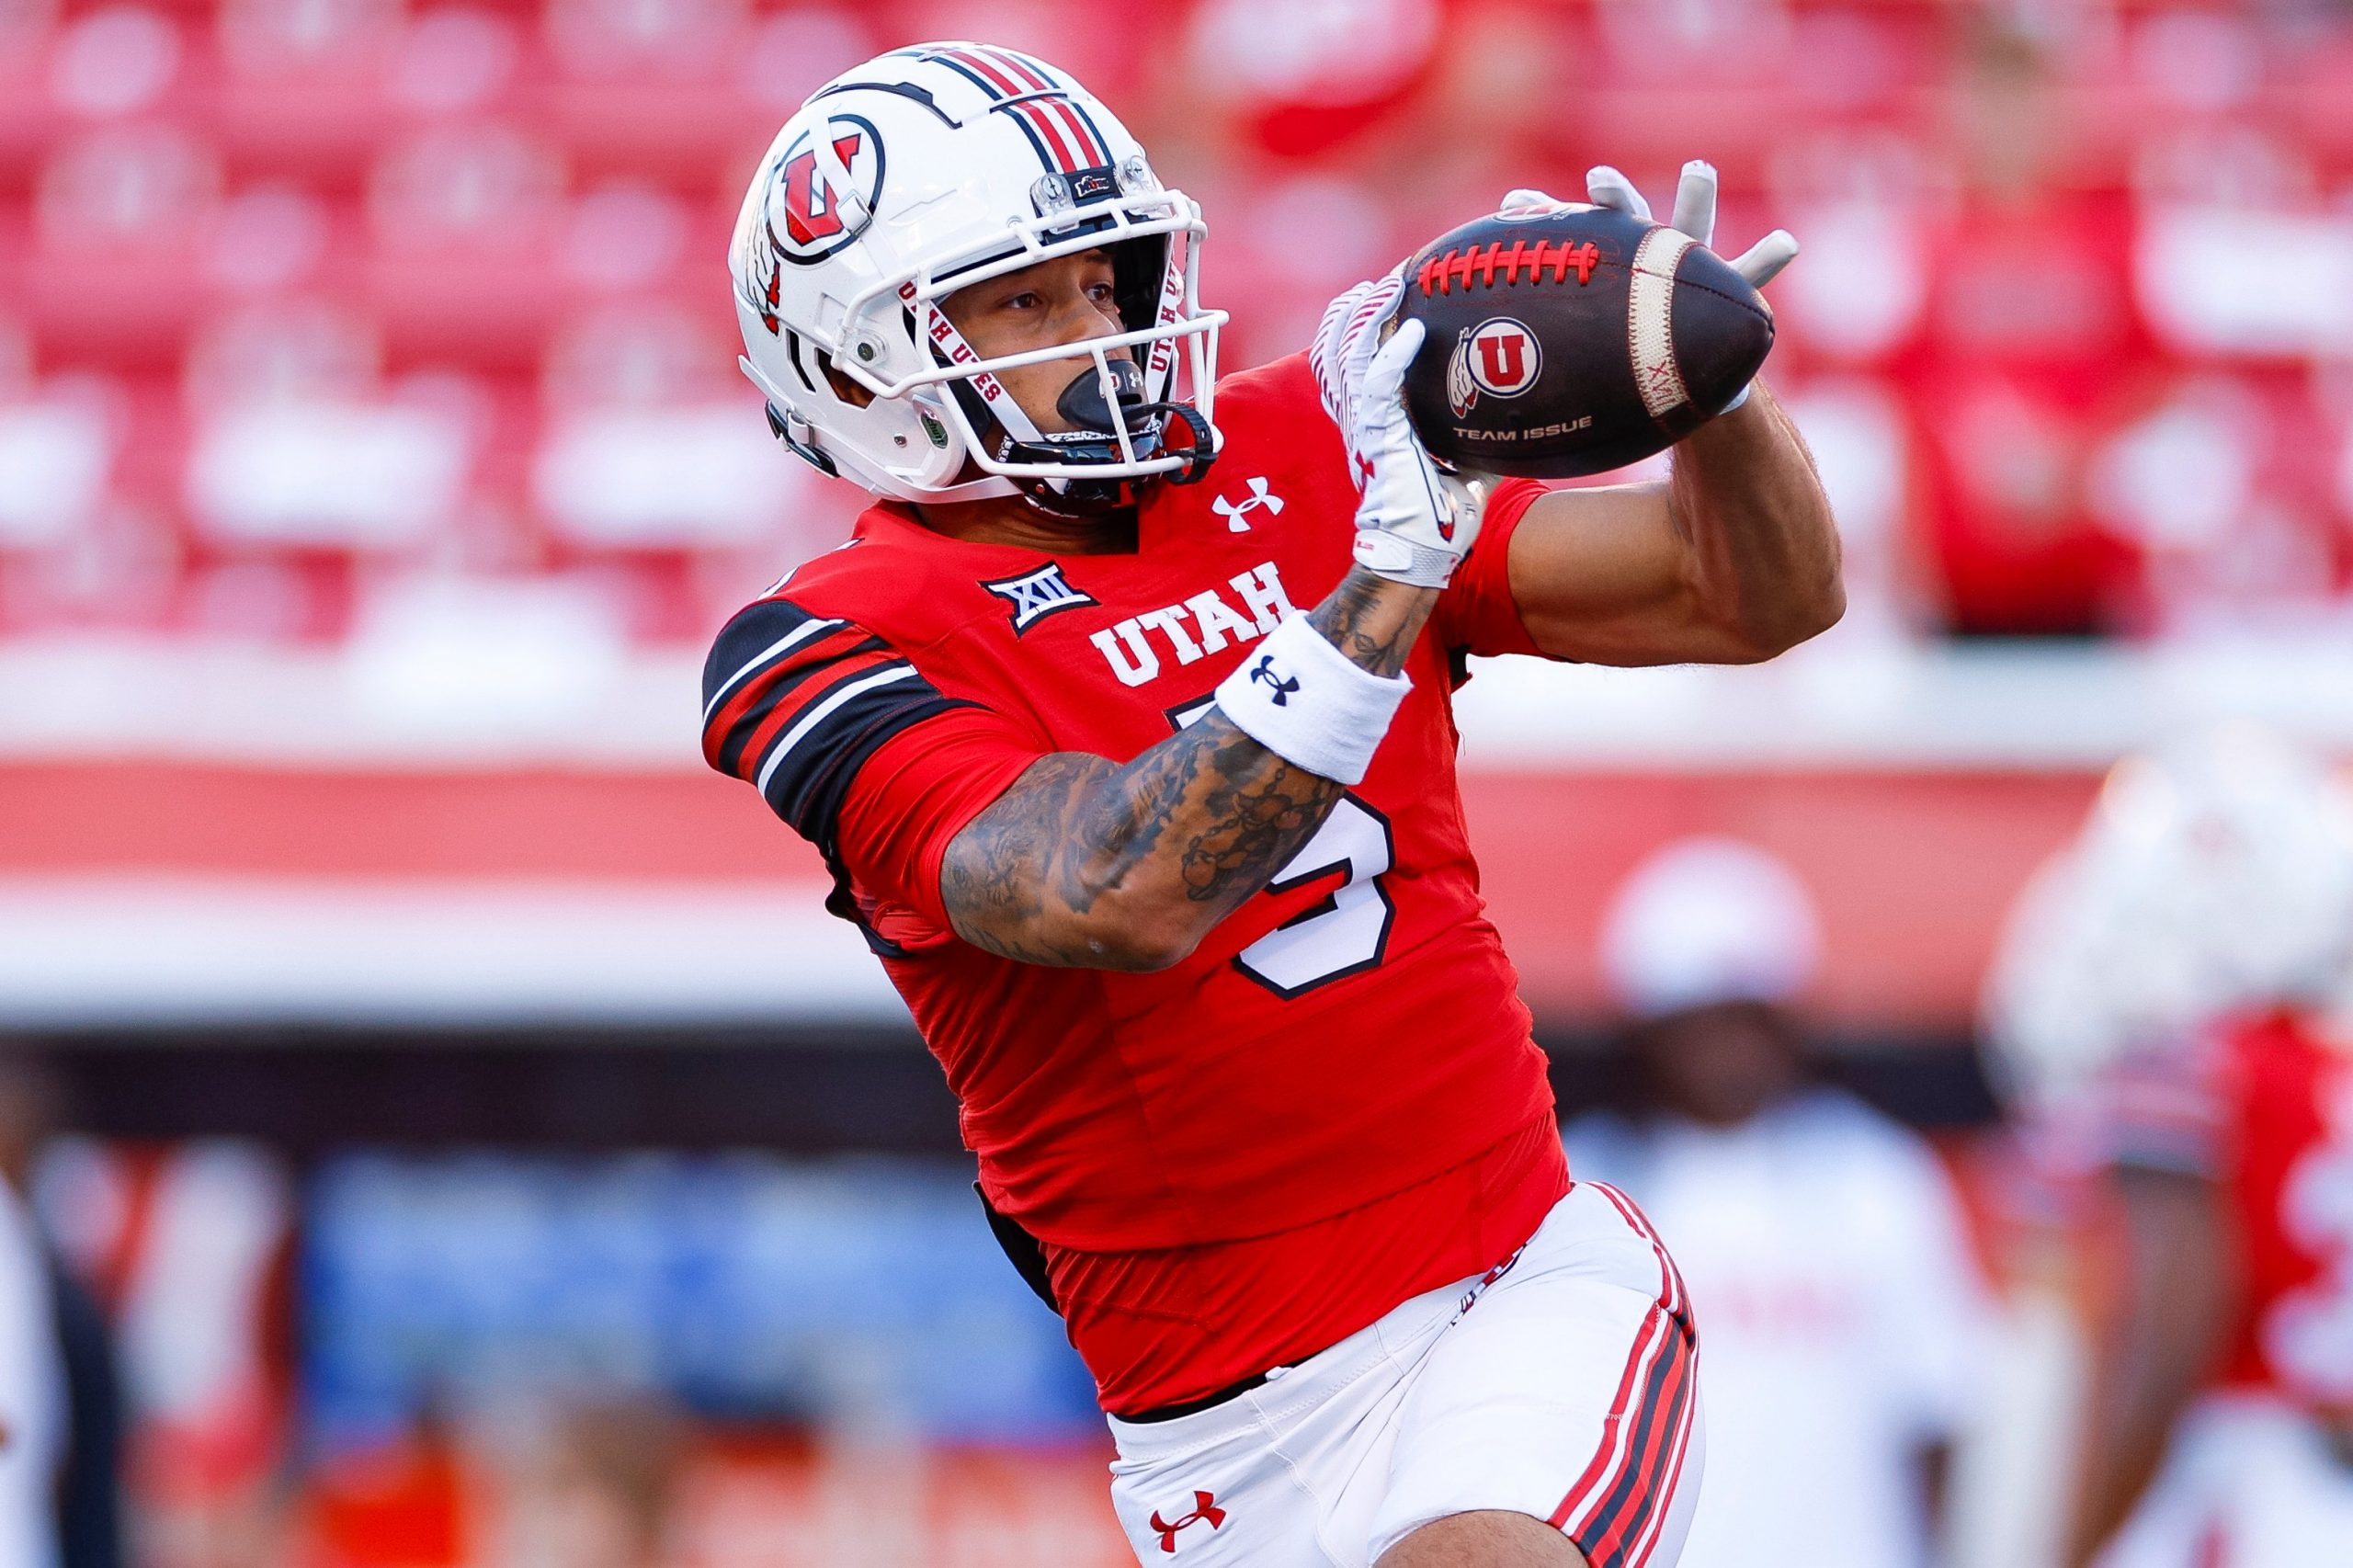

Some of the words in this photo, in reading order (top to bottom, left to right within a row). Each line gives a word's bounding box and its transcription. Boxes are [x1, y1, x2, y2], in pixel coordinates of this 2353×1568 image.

[781, 133, 861, 247] U
[898, 280, 953, 343] UH
[951, 343, 1001, 402] UES
[1151, 305, 1176, 372] UTH
[1477, 335, 1525, 387] U
[1452, 426, 1517, 441] TEAM
[1522, 415, 1593, 440] ISSUE
[988, 563, 1091, 629] XII
[1089, 561, 1297, 687] UTAH
